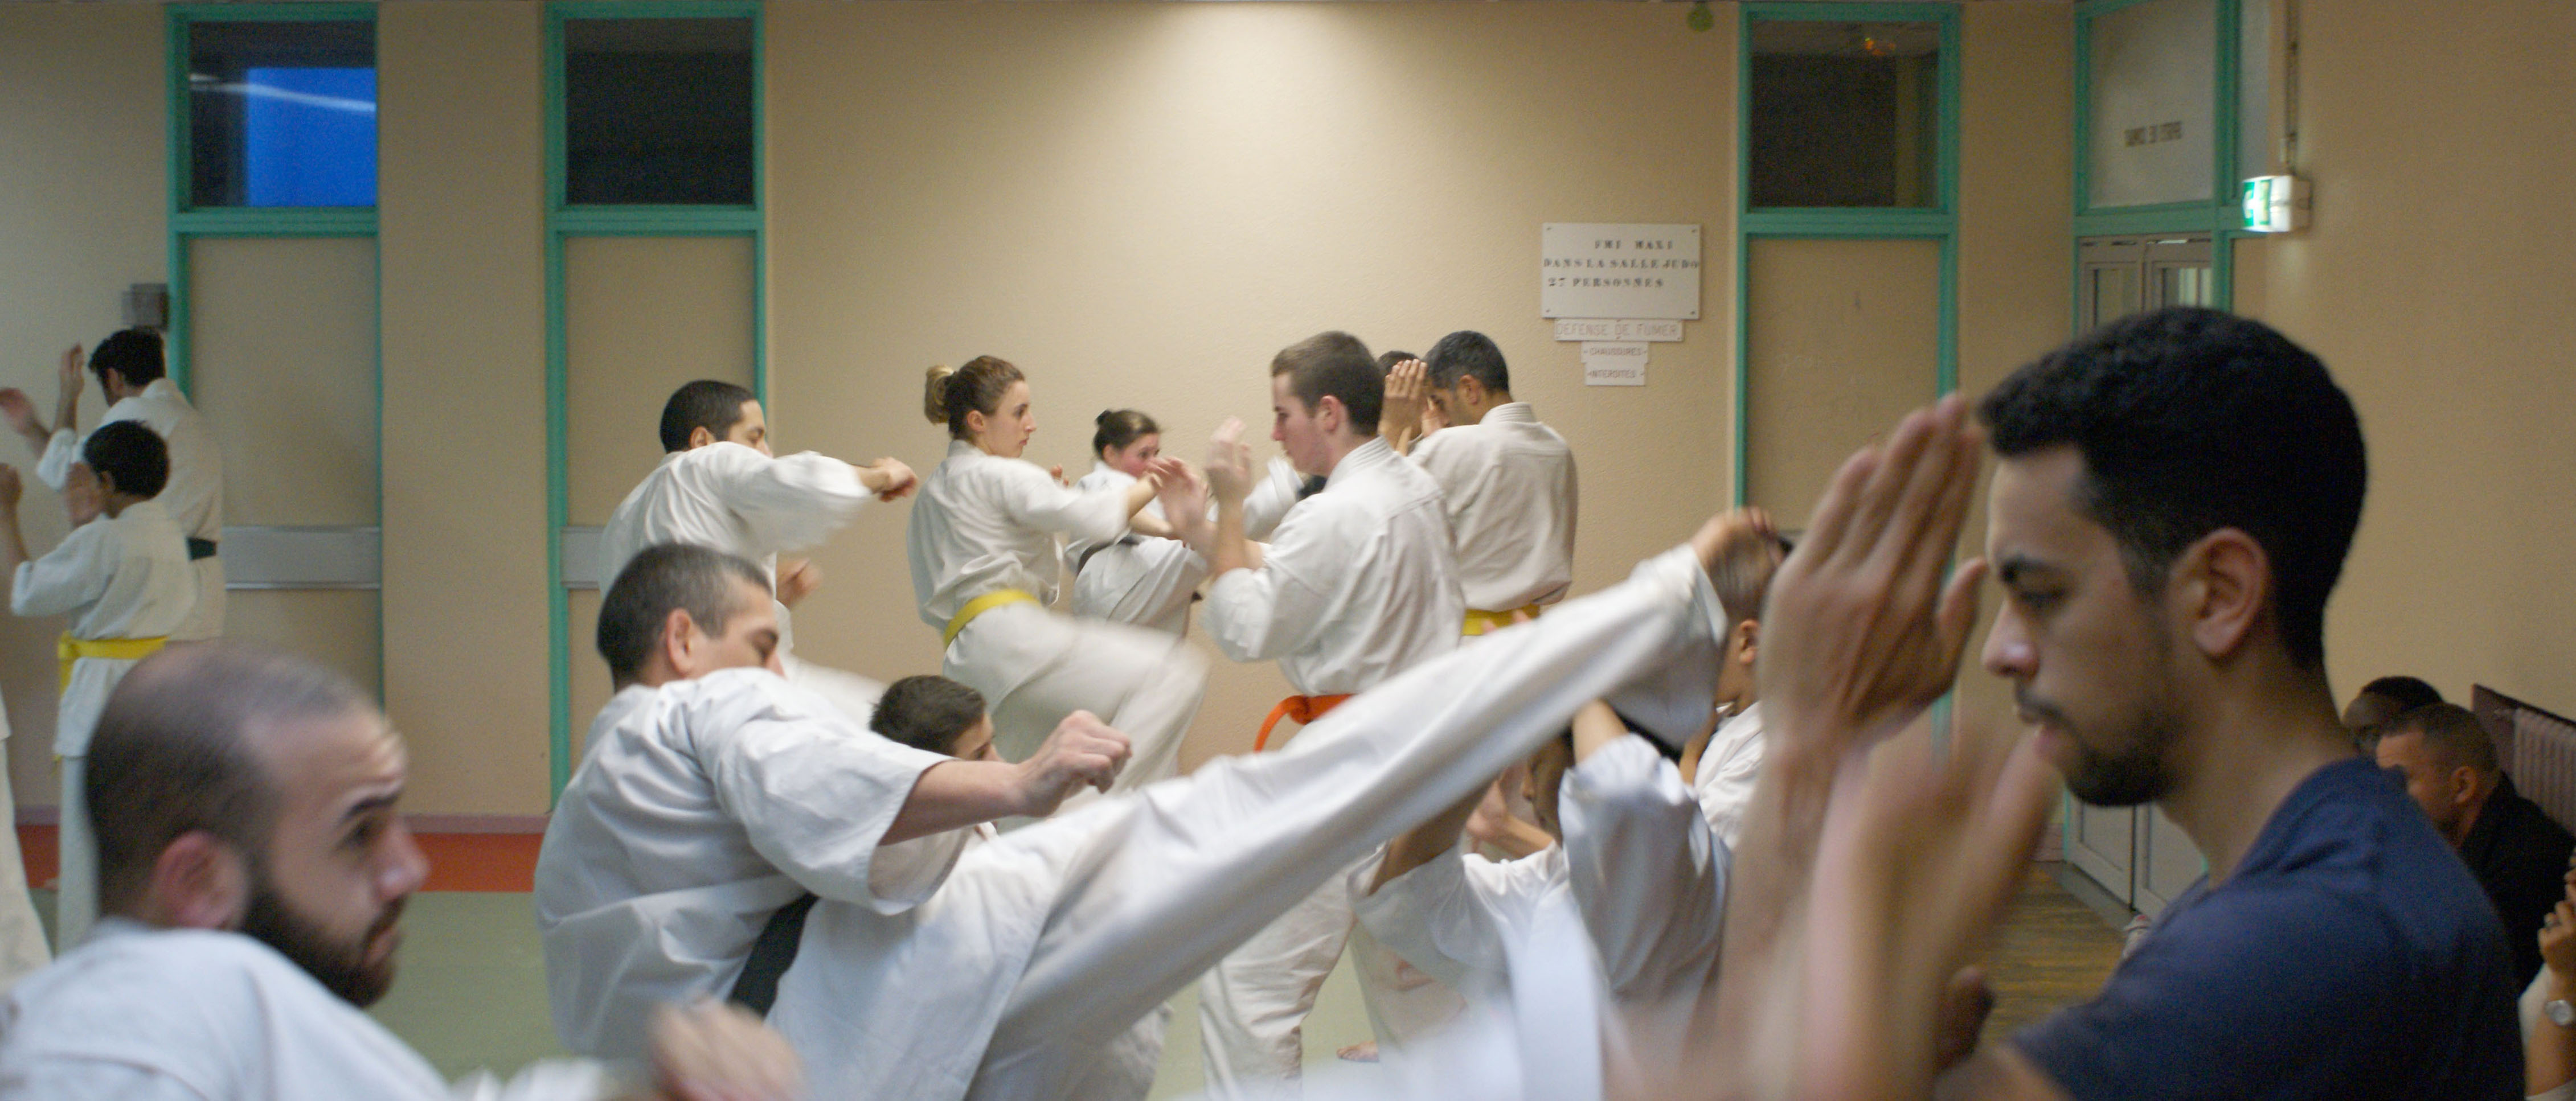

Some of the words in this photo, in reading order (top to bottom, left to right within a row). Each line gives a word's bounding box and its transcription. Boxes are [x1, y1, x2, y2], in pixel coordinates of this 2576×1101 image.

[1635, 240, 1674, 250] MAXI
[1543, 258, 1583, 268] DANS
[1586, 258, 1605, 268] LA
[1610, 258, 1658, 268] SALLE
[1662, 258, 1699, 268] JUDO
[1548, 277, 1566, 286] 27
[1572, 277, 1664, 286] PERSONNES
[1555, 323, 1608, 336] DEFENSE
[1614, 323, 1629, 336] DE
[1636, 323, 1677, 336] FUMER
